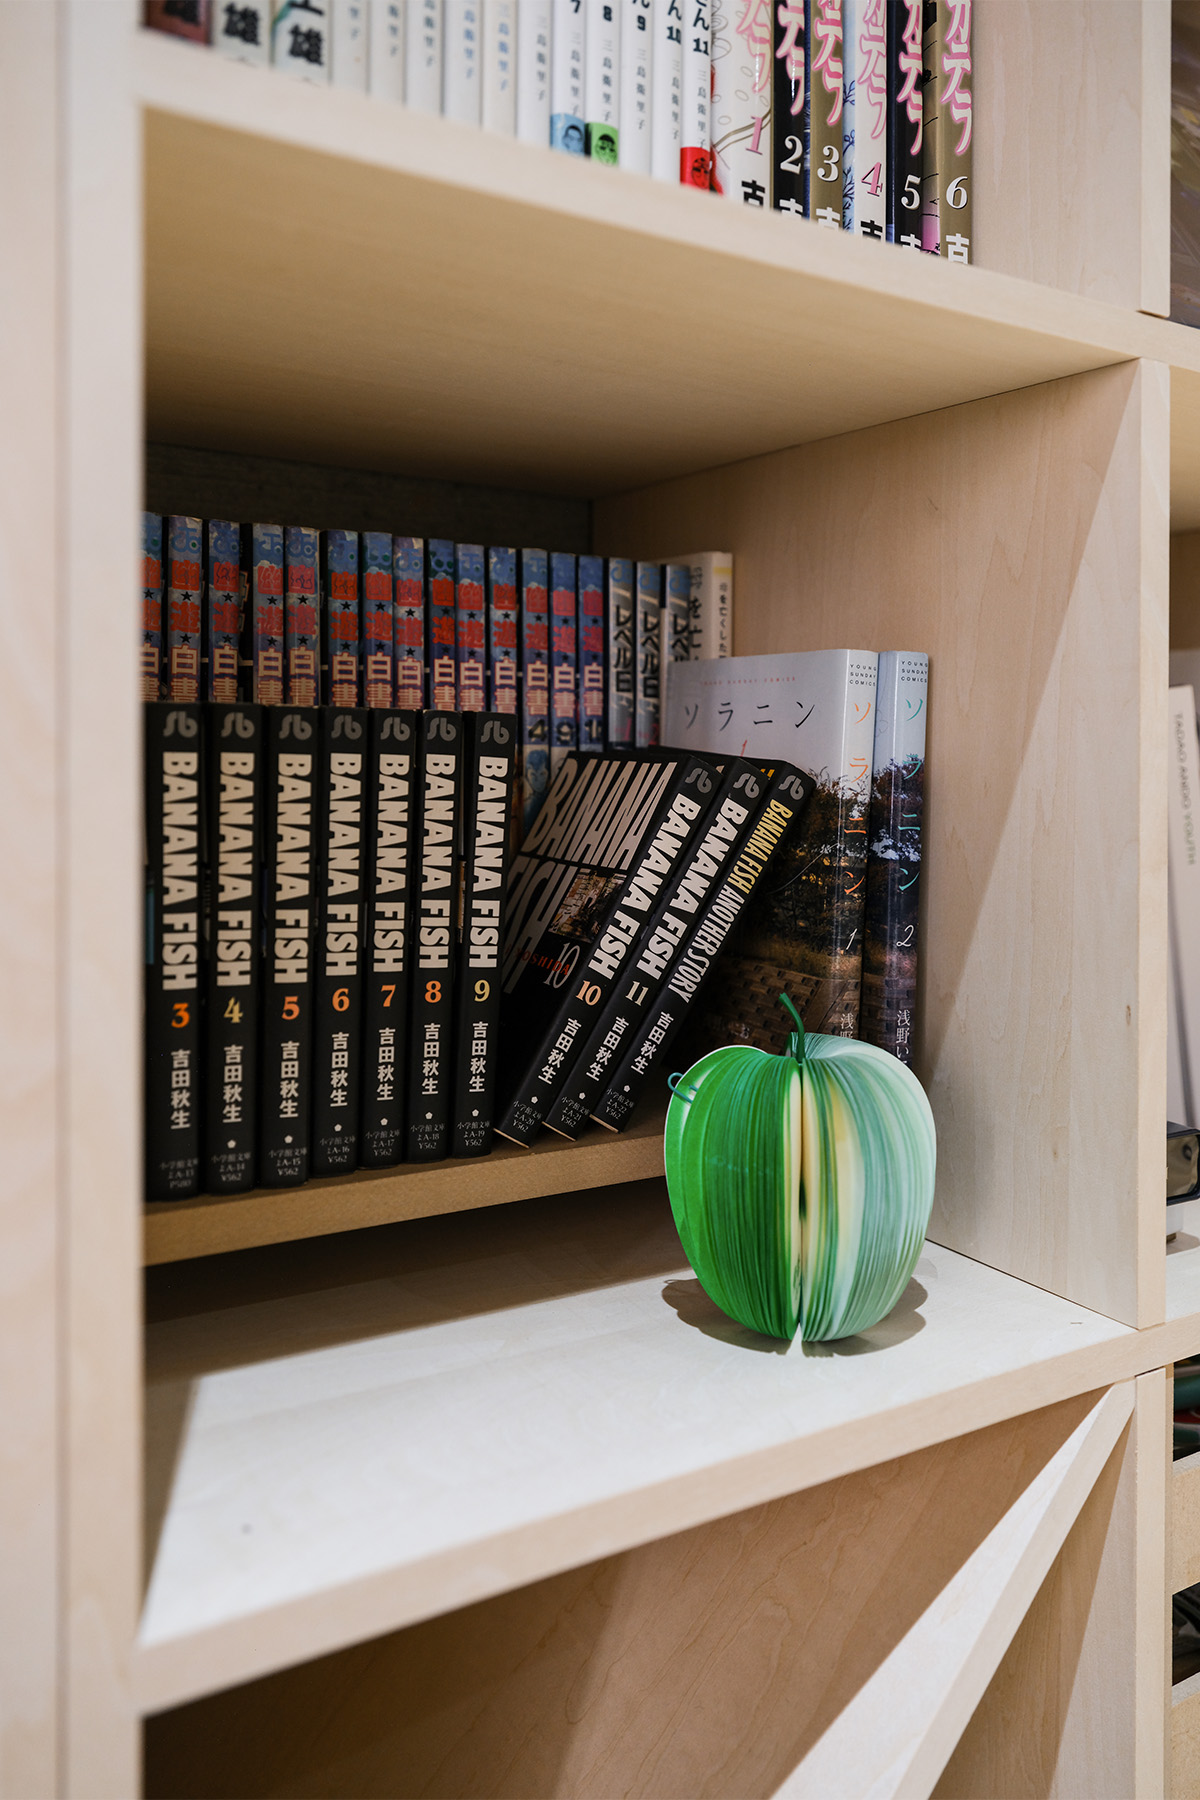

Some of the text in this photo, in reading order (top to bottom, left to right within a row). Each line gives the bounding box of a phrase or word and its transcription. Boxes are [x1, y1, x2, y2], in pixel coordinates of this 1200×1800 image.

[746, 116, 764, 155] 1
[780, 135, 803, 174] 2
[817, 145, 840, 181] 3
[861, 162, 883, 197] 4
[901, 174, 922, 210] 5
[946, 176, 969, 210] 6
[684, 701, 815, 732] ソラニン
[520, 758, 677, 870] BANANA
[844, 702, 871, 894] ソラニン
[898, 699, 923, 892] ソラニン
[161, 751, 199, 991] BANANA FISH
[216, 751, 255, 987] BANANA FISH
[274, 752, 312, 984] BANANA FISH
[325, 752, 362, 977] BANANA FISH
[372, 753, 411, 973] BANANA FISH
[418, 753, 456, 969] BANANA FISH
[468, 755, 509, 969] BANANA FISH
[587, 793, 702, 981] BANANA FISH
[636, 795, 750, 981] BANANA FISH
[668, 799, 793, 1003] BANANA FISH ANOTHER STORY
[896, 924, 915, 948] 2
[171, 1002, 190, 1029] 3
[223, 996, 244, 1024] 4
[281, 995, 300, 1020] 5
[331, 988, 350, 1012] 6
[380, 984, 396, 1007] 7
[424, 980, 442, 1003] 8
[473, 979, 491, 1003] 9
[575, 979, 602, 1007] 10
[625, 980, 649, 1007] 11
[330, 1031, 349, 1107] 吉田秋生
[376, 1027, 396, 1102] 吉田秋生
[421, 1023, 441, 1095] 吉田秋生
[469, 1021, 488, 1093] 吉田秋生
[538, 1017, 582, 1085] 吉田秋生
[585, 1016, 629, 1082] 吉田秋生
[631, 1011, 674, 1075] 吉田秋生
[895, 1009, 911, 1063] 浅野い
[170, 1049, 192, 1130] 吉田秋生
[222, 1044, 244, 1123] 吉田秋生
[279, 1040, 300, 1119] 吉田秋生
